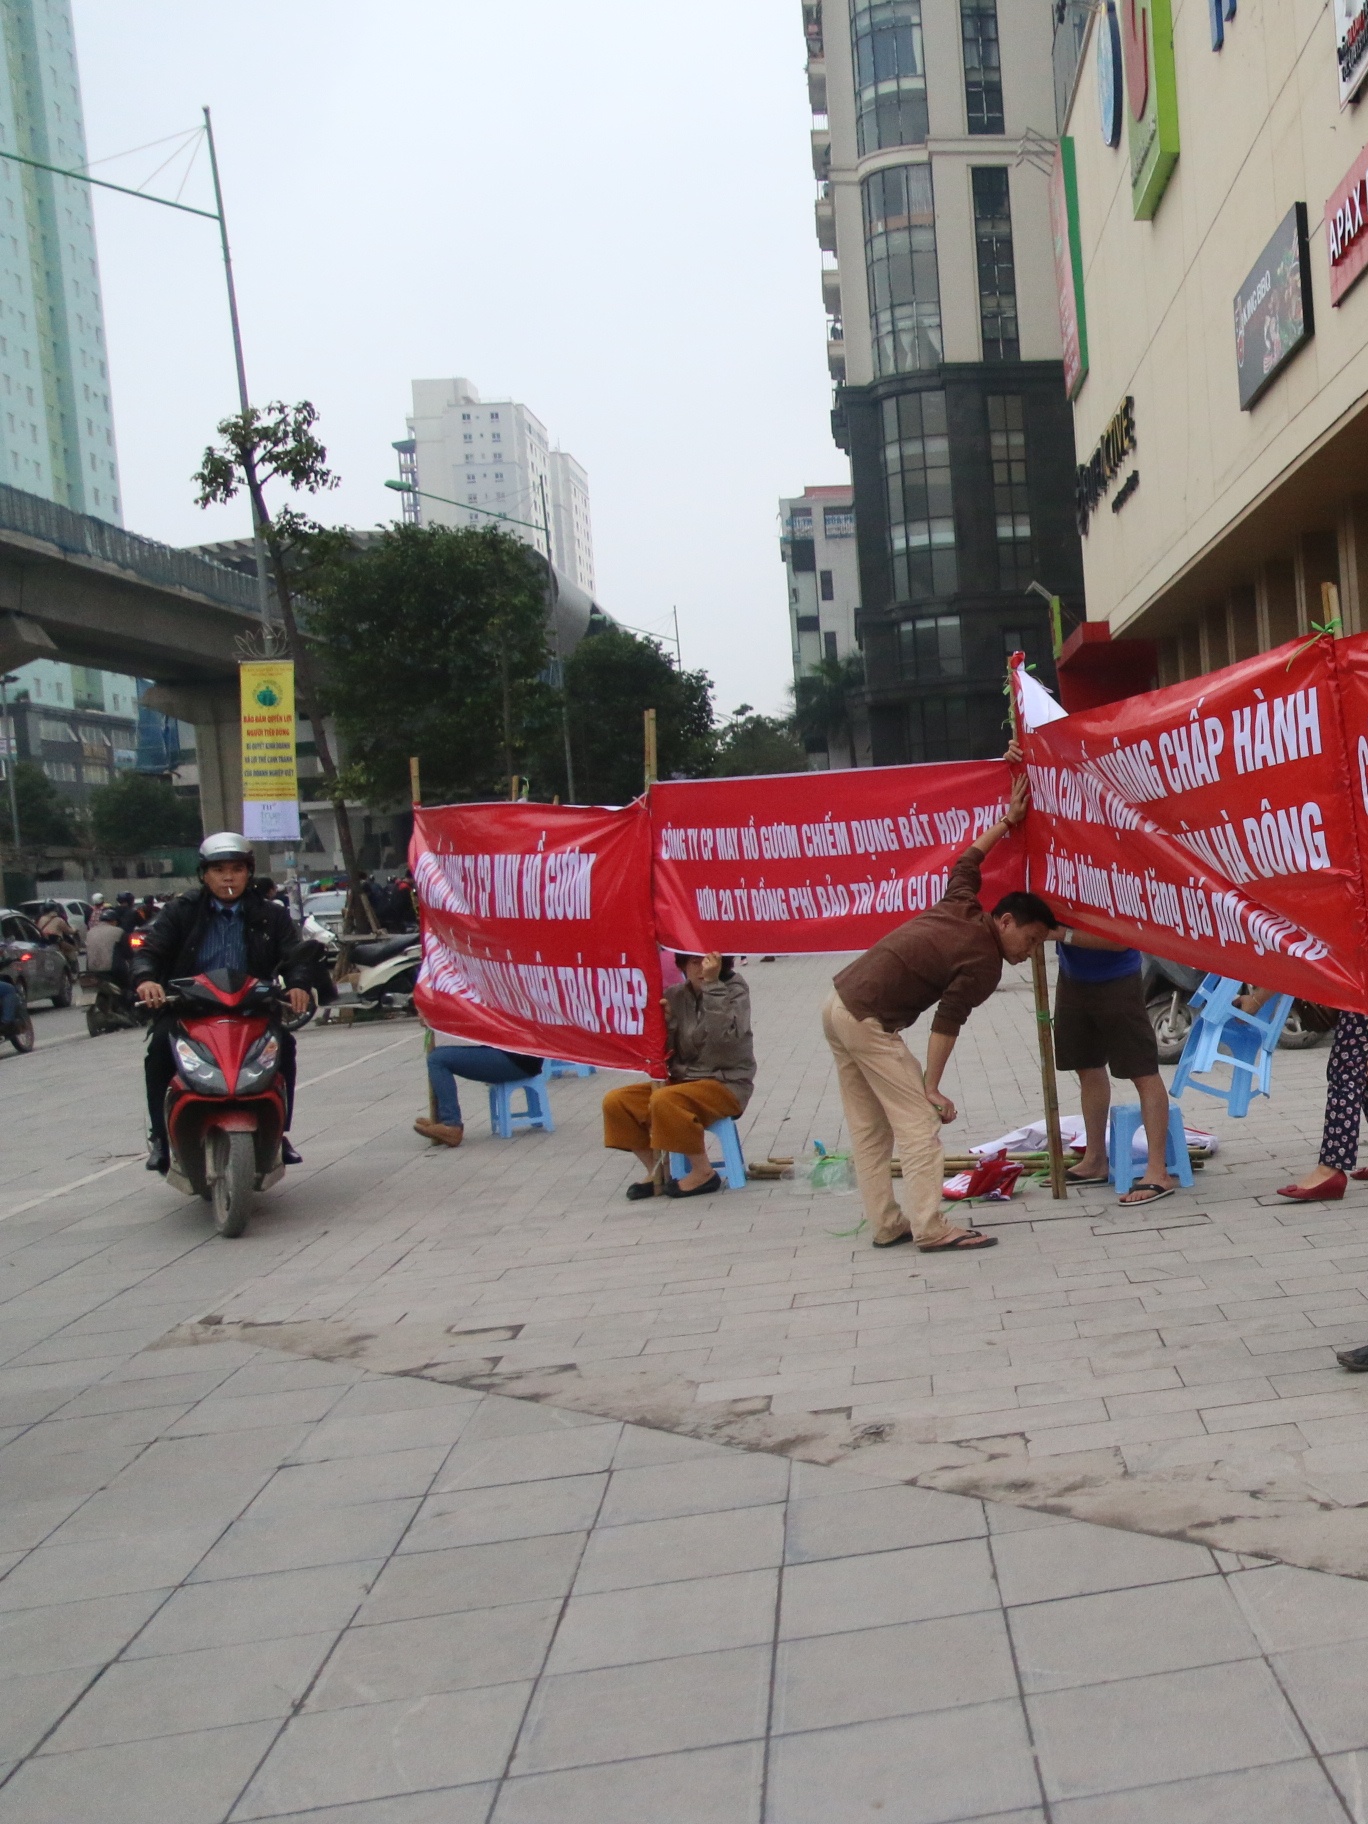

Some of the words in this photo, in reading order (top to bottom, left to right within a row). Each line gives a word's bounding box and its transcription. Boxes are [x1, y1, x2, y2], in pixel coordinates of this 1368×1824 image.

[1328, 180, 1363, 266] APAX
[1158, 697, 1225, 794] CHẤP
[1231, 686, 1322, 775] HÀNH
[662, 821, 687, 861] CÔNG
[687, 828, 699, 860] TY
[700, 828, 713, 861] CP
[715, 827, 740, 860] MAY
[740, 815, 760, 860] HỒ
[760, 822, 802, 860] GƯƠM
[801, 811, 852, 858] CHIẾM
[850, 817, 900, 861] DỤNG
[897, 802, 935, 849] BẤT
[933, 807, 971, 851] HỢP
[1209, 809, 1259, 884] HÀ
[1242, 798, 1331, 878] ĐÔNG
[478, 854, 491, 918] CP
[494, 854, 521, 919] MAY
[544, 846, 597, 921] GƯƠM
[719, 889, 735, 921] 20
[734, 877, 751, 921] TỶ
[750, 876, 790, 921] ĐỒNG
[788, 879, 818, 919] PHÍ
[815, 874, 850, 918] BẢO
[850, 875, 875, 916] TRÌ
[876, 867, 904, 914] CỦA
[907, 871, 928, 910] CƯ
[1144, 867, 1184, 937] tăng
[1181, 876, 1214, 940] giá
[557, 952, 600, 1033] TRÁI
[597, 952, 648, 1036] PHÉP
